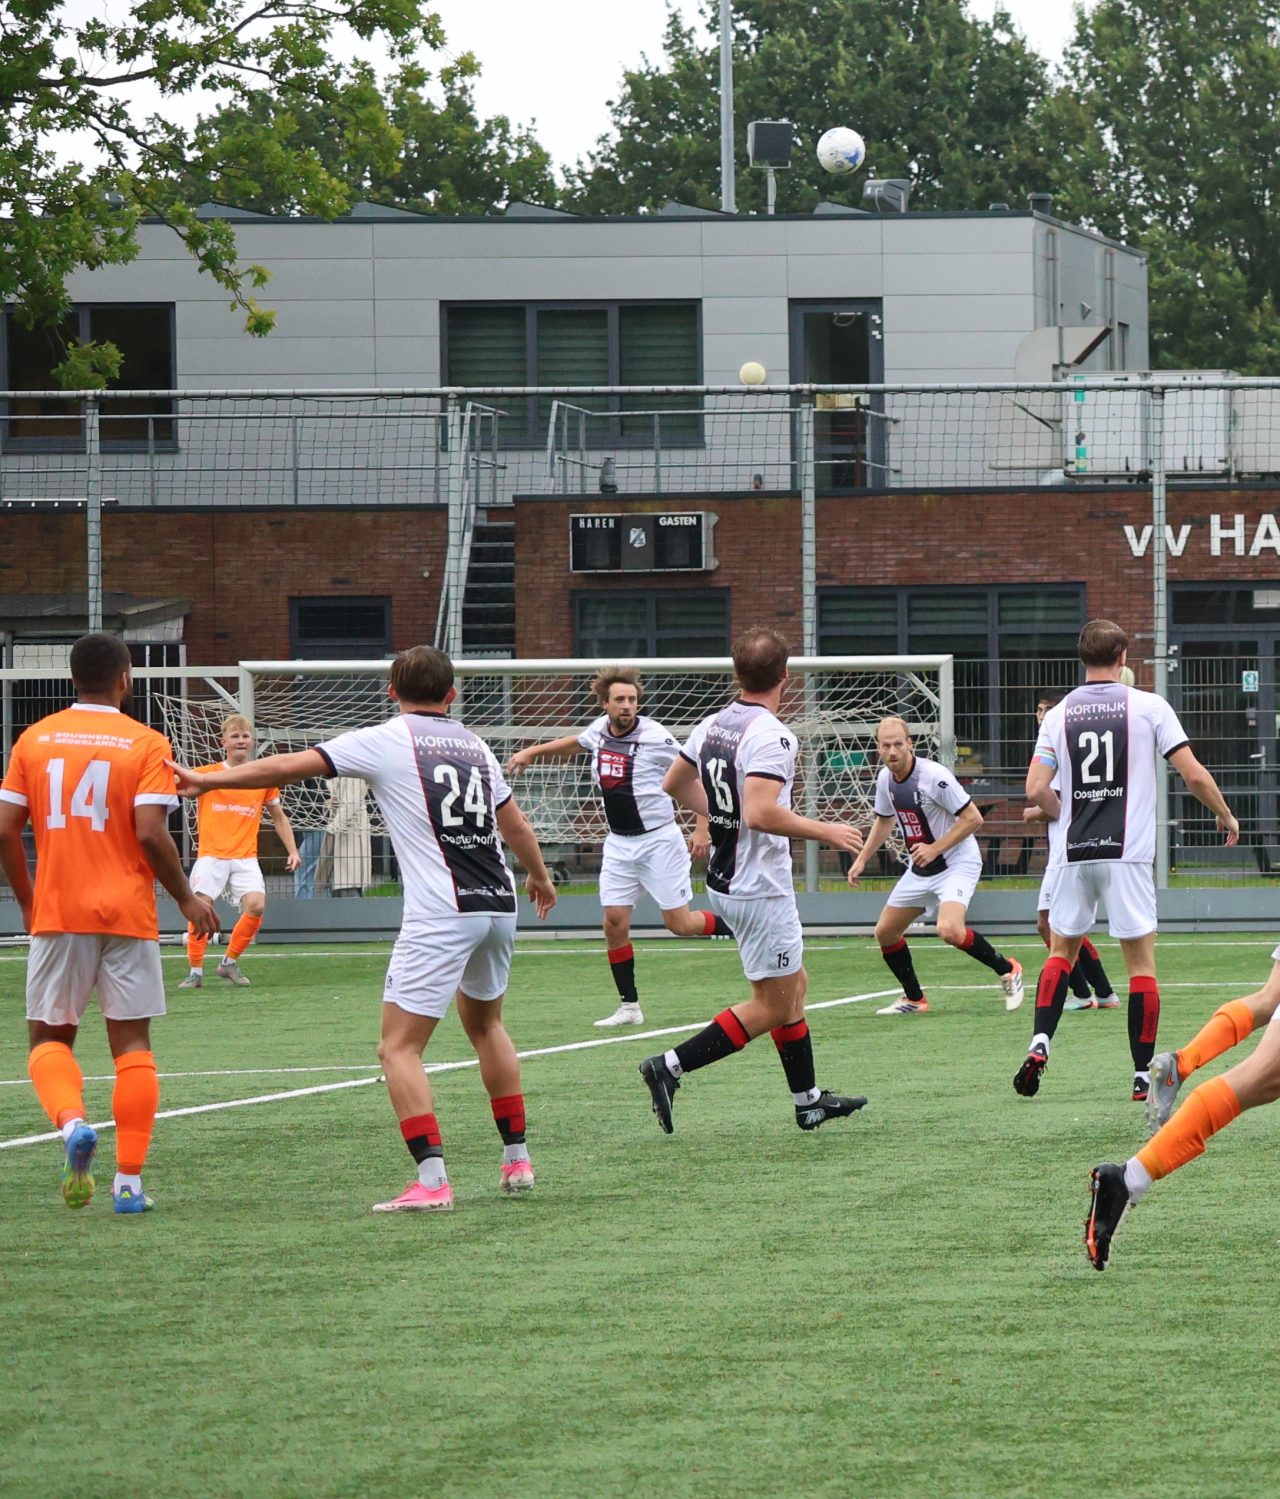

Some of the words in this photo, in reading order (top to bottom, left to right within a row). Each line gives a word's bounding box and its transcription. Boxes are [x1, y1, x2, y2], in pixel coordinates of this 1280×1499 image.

[579, 518, 615, 529] HAREN
[659, 516, 697, 527] GASTEN
[1066, 702, 1126, 717] KORTRIJK
[414, 735, 482, 753] KORTRIJK
[1078, 730, 1114, 784] 21
[45, 758, 111, 832] 14
[706, 758, 734, 814] 15
[1074, 787, 1123, 800] Oosterhoff
[433, 764, 488, 828] 24
[777, 950, 789, 969] 15
